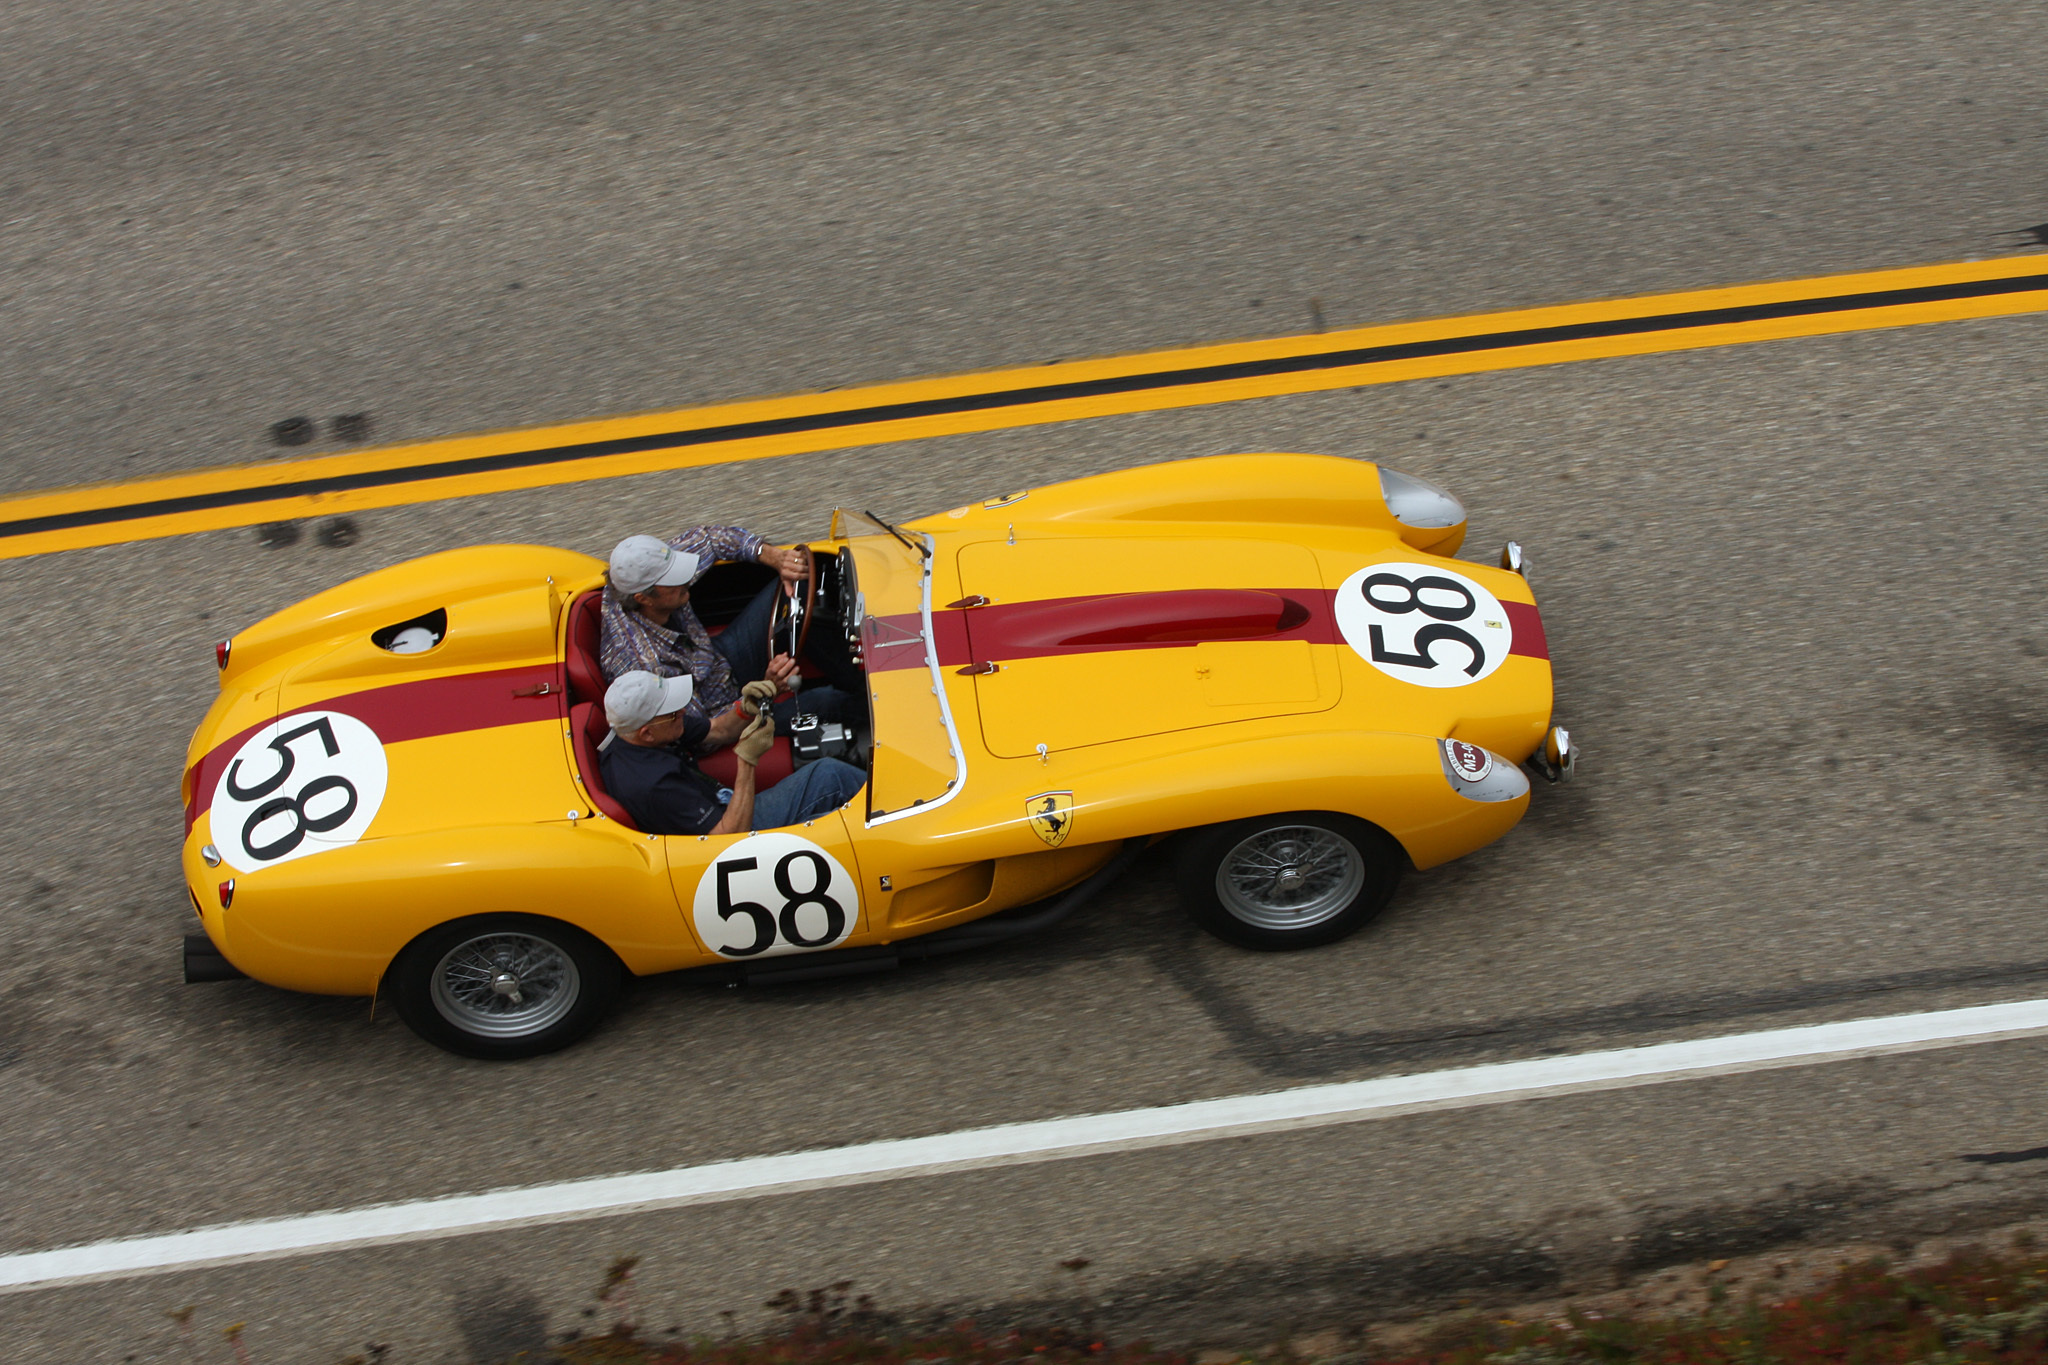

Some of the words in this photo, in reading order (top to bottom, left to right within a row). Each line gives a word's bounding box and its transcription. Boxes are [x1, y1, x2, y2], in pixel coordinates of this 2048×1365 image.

[1361, 572, 1486, 678] 58
[227, 716, 357, 861] 58
[717, 850, 846, 950] 58
